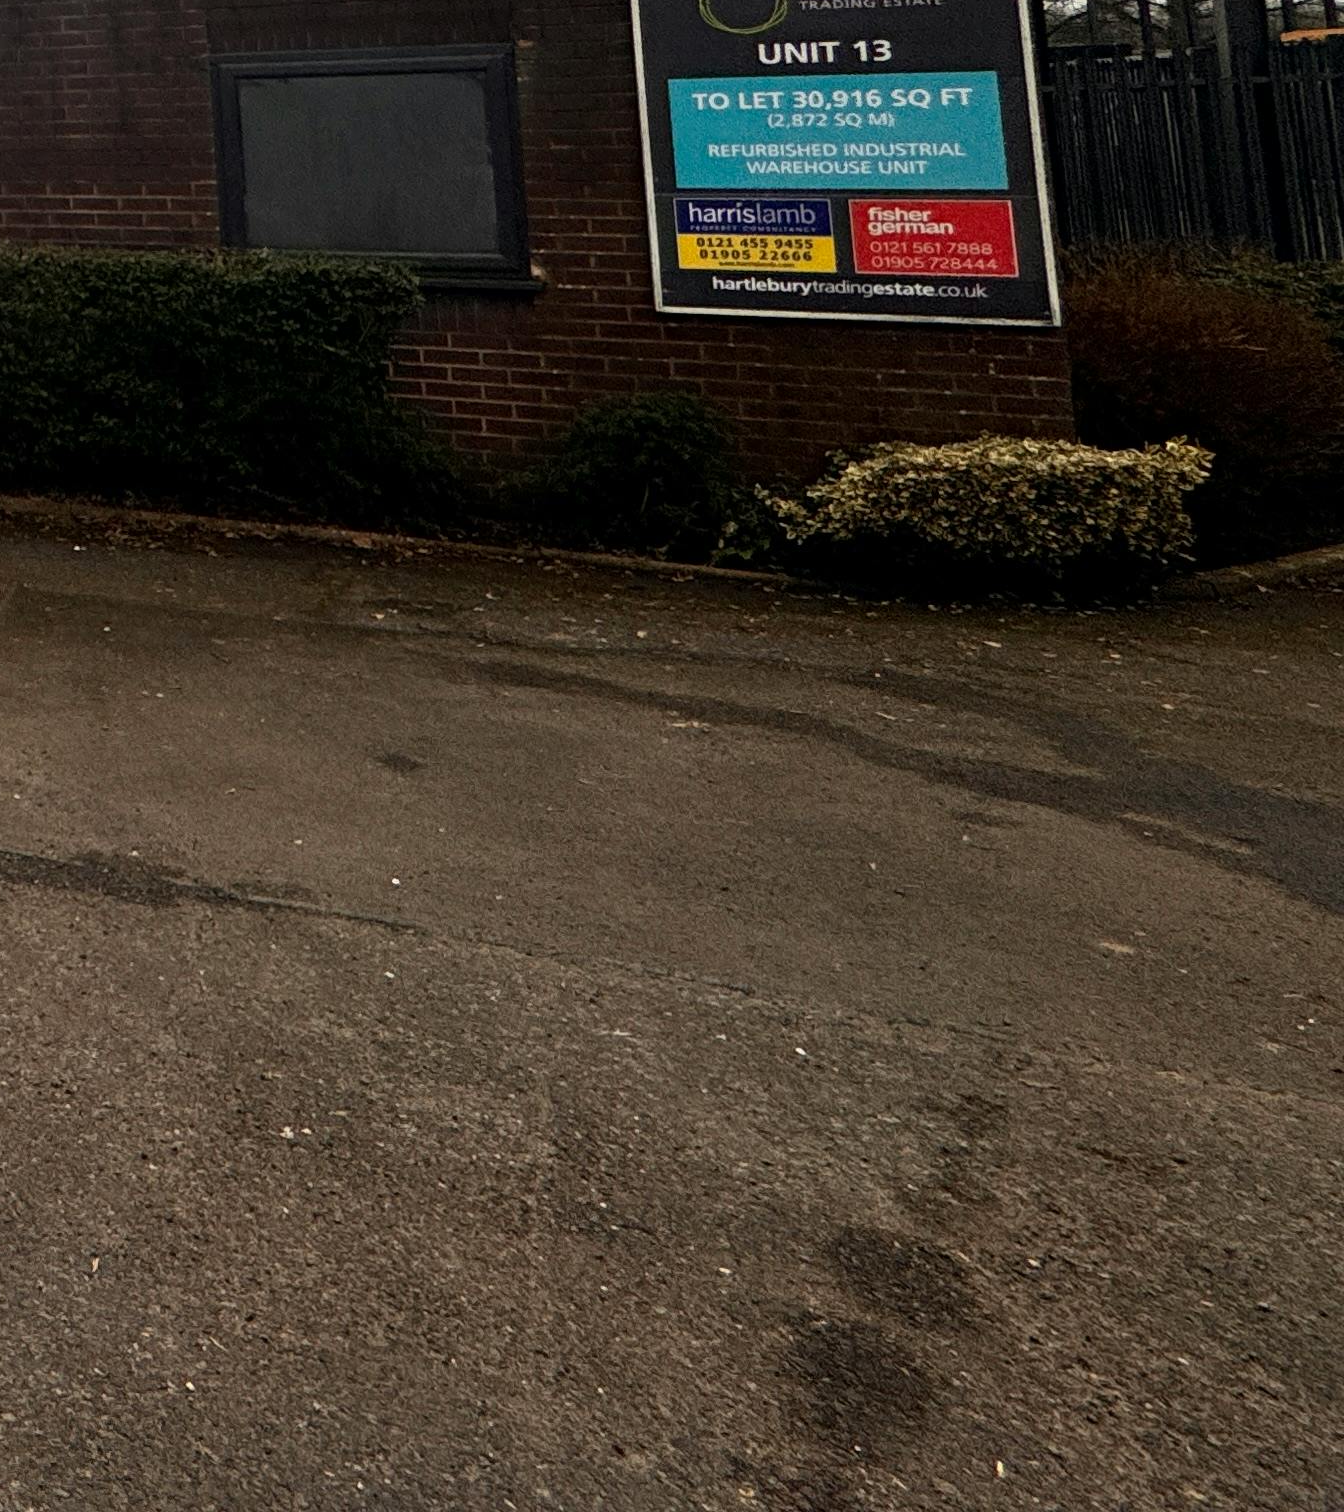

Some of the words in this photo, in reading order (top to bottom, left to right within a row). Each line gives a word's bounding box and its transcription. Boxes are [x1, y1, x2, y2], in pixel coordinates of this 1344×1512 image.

[758, 41, 840, 65] UNIT
[853, 39, 894, 63] 13
[692, 92, 730, 110] TO
[738, 91, 784, 109] LET
[792, 89, 882, 110] 30,916
[890, 88, 931, 109] SQ
[940, 87, 973, 106] FT
[767, 113, 828, 129] (2,872
[834, 112, 862, 128] SQ
[868, 112, 896, 127] M)
[708, 143, 838, 158] REFURBISHED
[844, 143, 966, 157] INDUSTRIAL
[746, 160, 872, 175] WAREHOUSE
[878, 160, 928, 174] UNIT
[688, 202, 816, 225] harrislamb
[868, 207, 932, 222] fisher
[868, 222, 955, 236] german
[696, 238, 734, 248] 0121
[740, 238, 768, 249] 455
[774, 238, 813, 250] 9455
[870, 241, 907, 254] 0121
[912, 241, 941, 255] 561
[947, 242, 993, 255] 7888
[699, 250, 751, 260] 01905
[759, 251, 813, 262] 22666
[871, 256, 925, 269] 01905
[928, 257, 999, 270] 728444
[712, 276, 989, 298] hartleburytradingestate.co.uk
